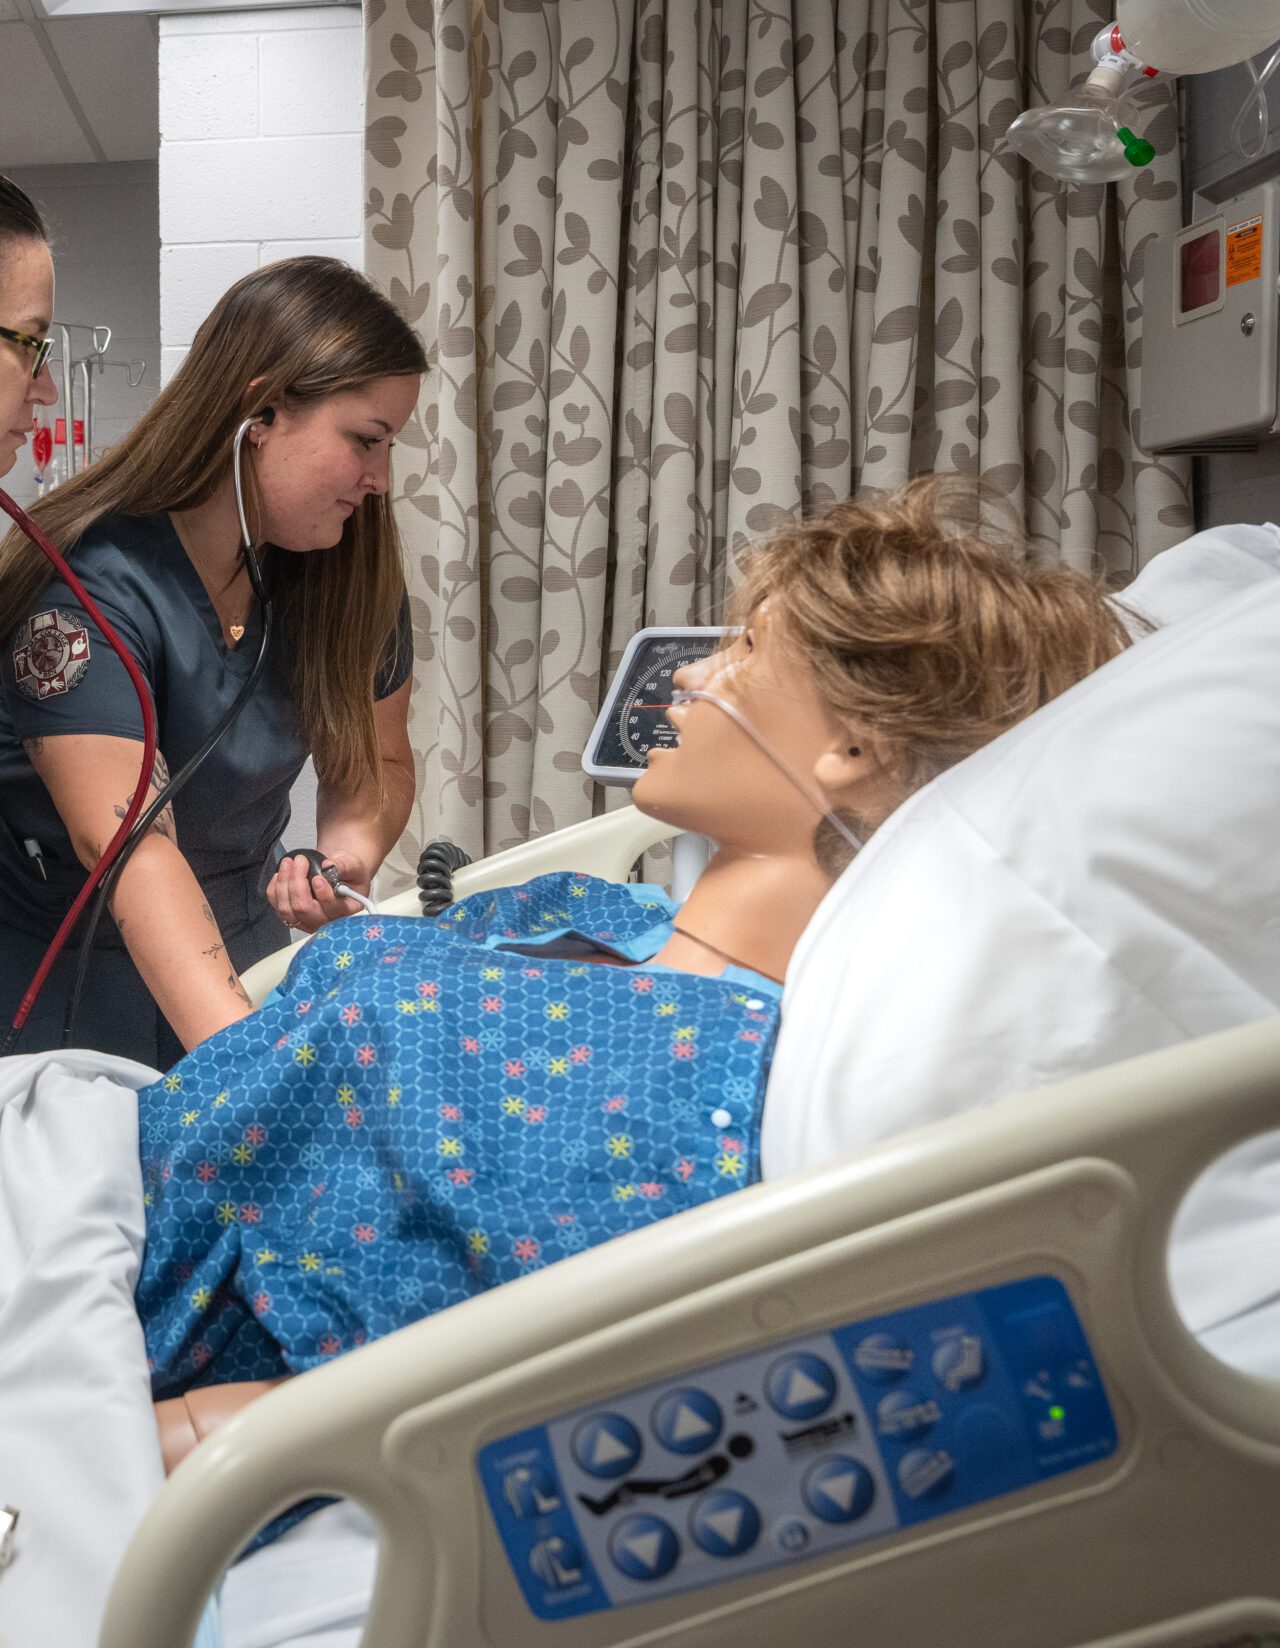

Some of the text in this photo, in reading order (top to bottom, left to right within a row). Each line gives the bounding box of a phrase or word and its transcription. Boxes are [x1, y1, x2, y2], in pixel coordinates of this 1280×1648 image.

[40, 630, 69, 648] COLLEGE
[660, 669, 672, 677] 120
[629, 716, 638, 724] 60
[639, 744, 649, 752] 20
